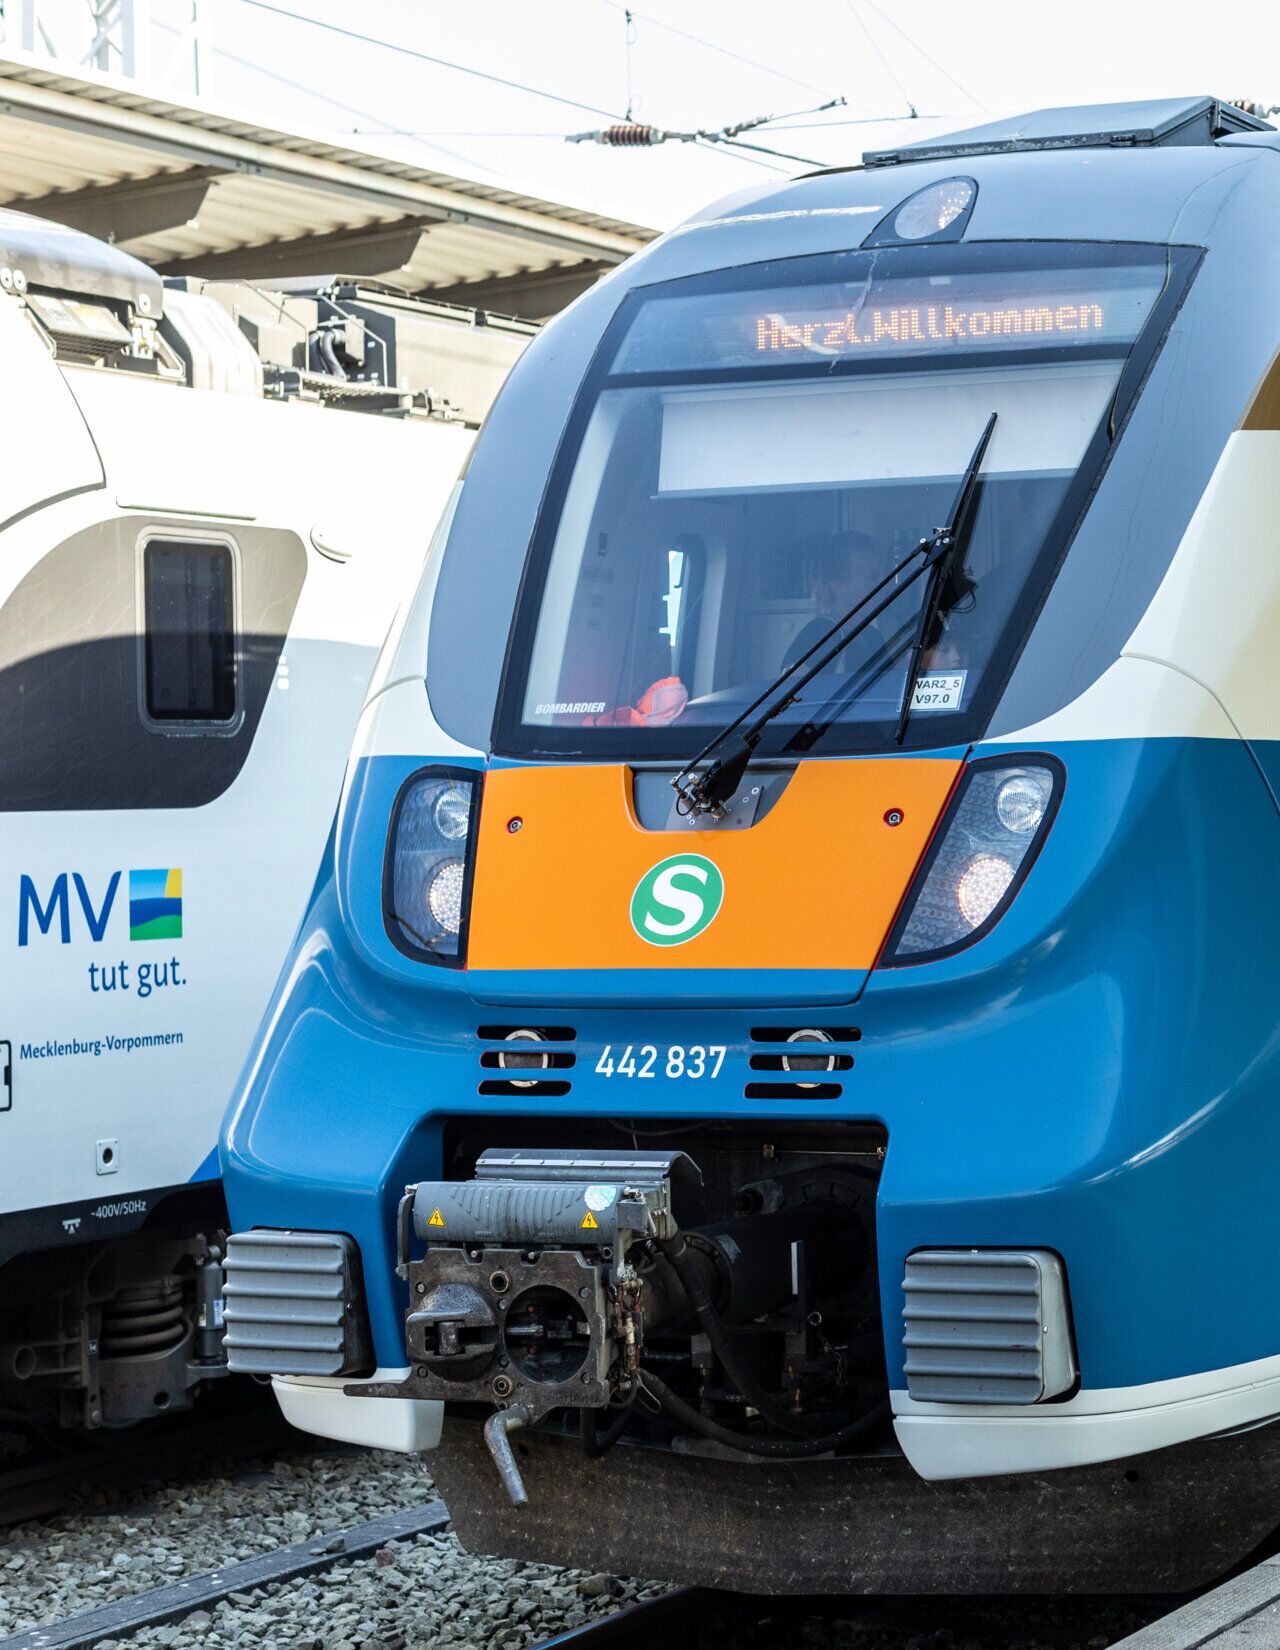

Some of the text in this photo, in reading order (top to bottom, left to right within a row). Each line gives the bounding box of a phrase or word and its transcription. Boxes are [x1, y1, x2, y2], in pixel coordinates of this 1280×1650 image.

[534, 702, 606, 714] BOMBARDIER
[915, 694, 950, 704] V97.0
[18, 871, 122, 946] MV
[644, 864, 708, 936] S
[88, 957, 186, 997] tut gut.
[20, 1032, 184, 1060] Mecklenburg-Vorpommern
[595, 1045, 727, 1079] 442 837
